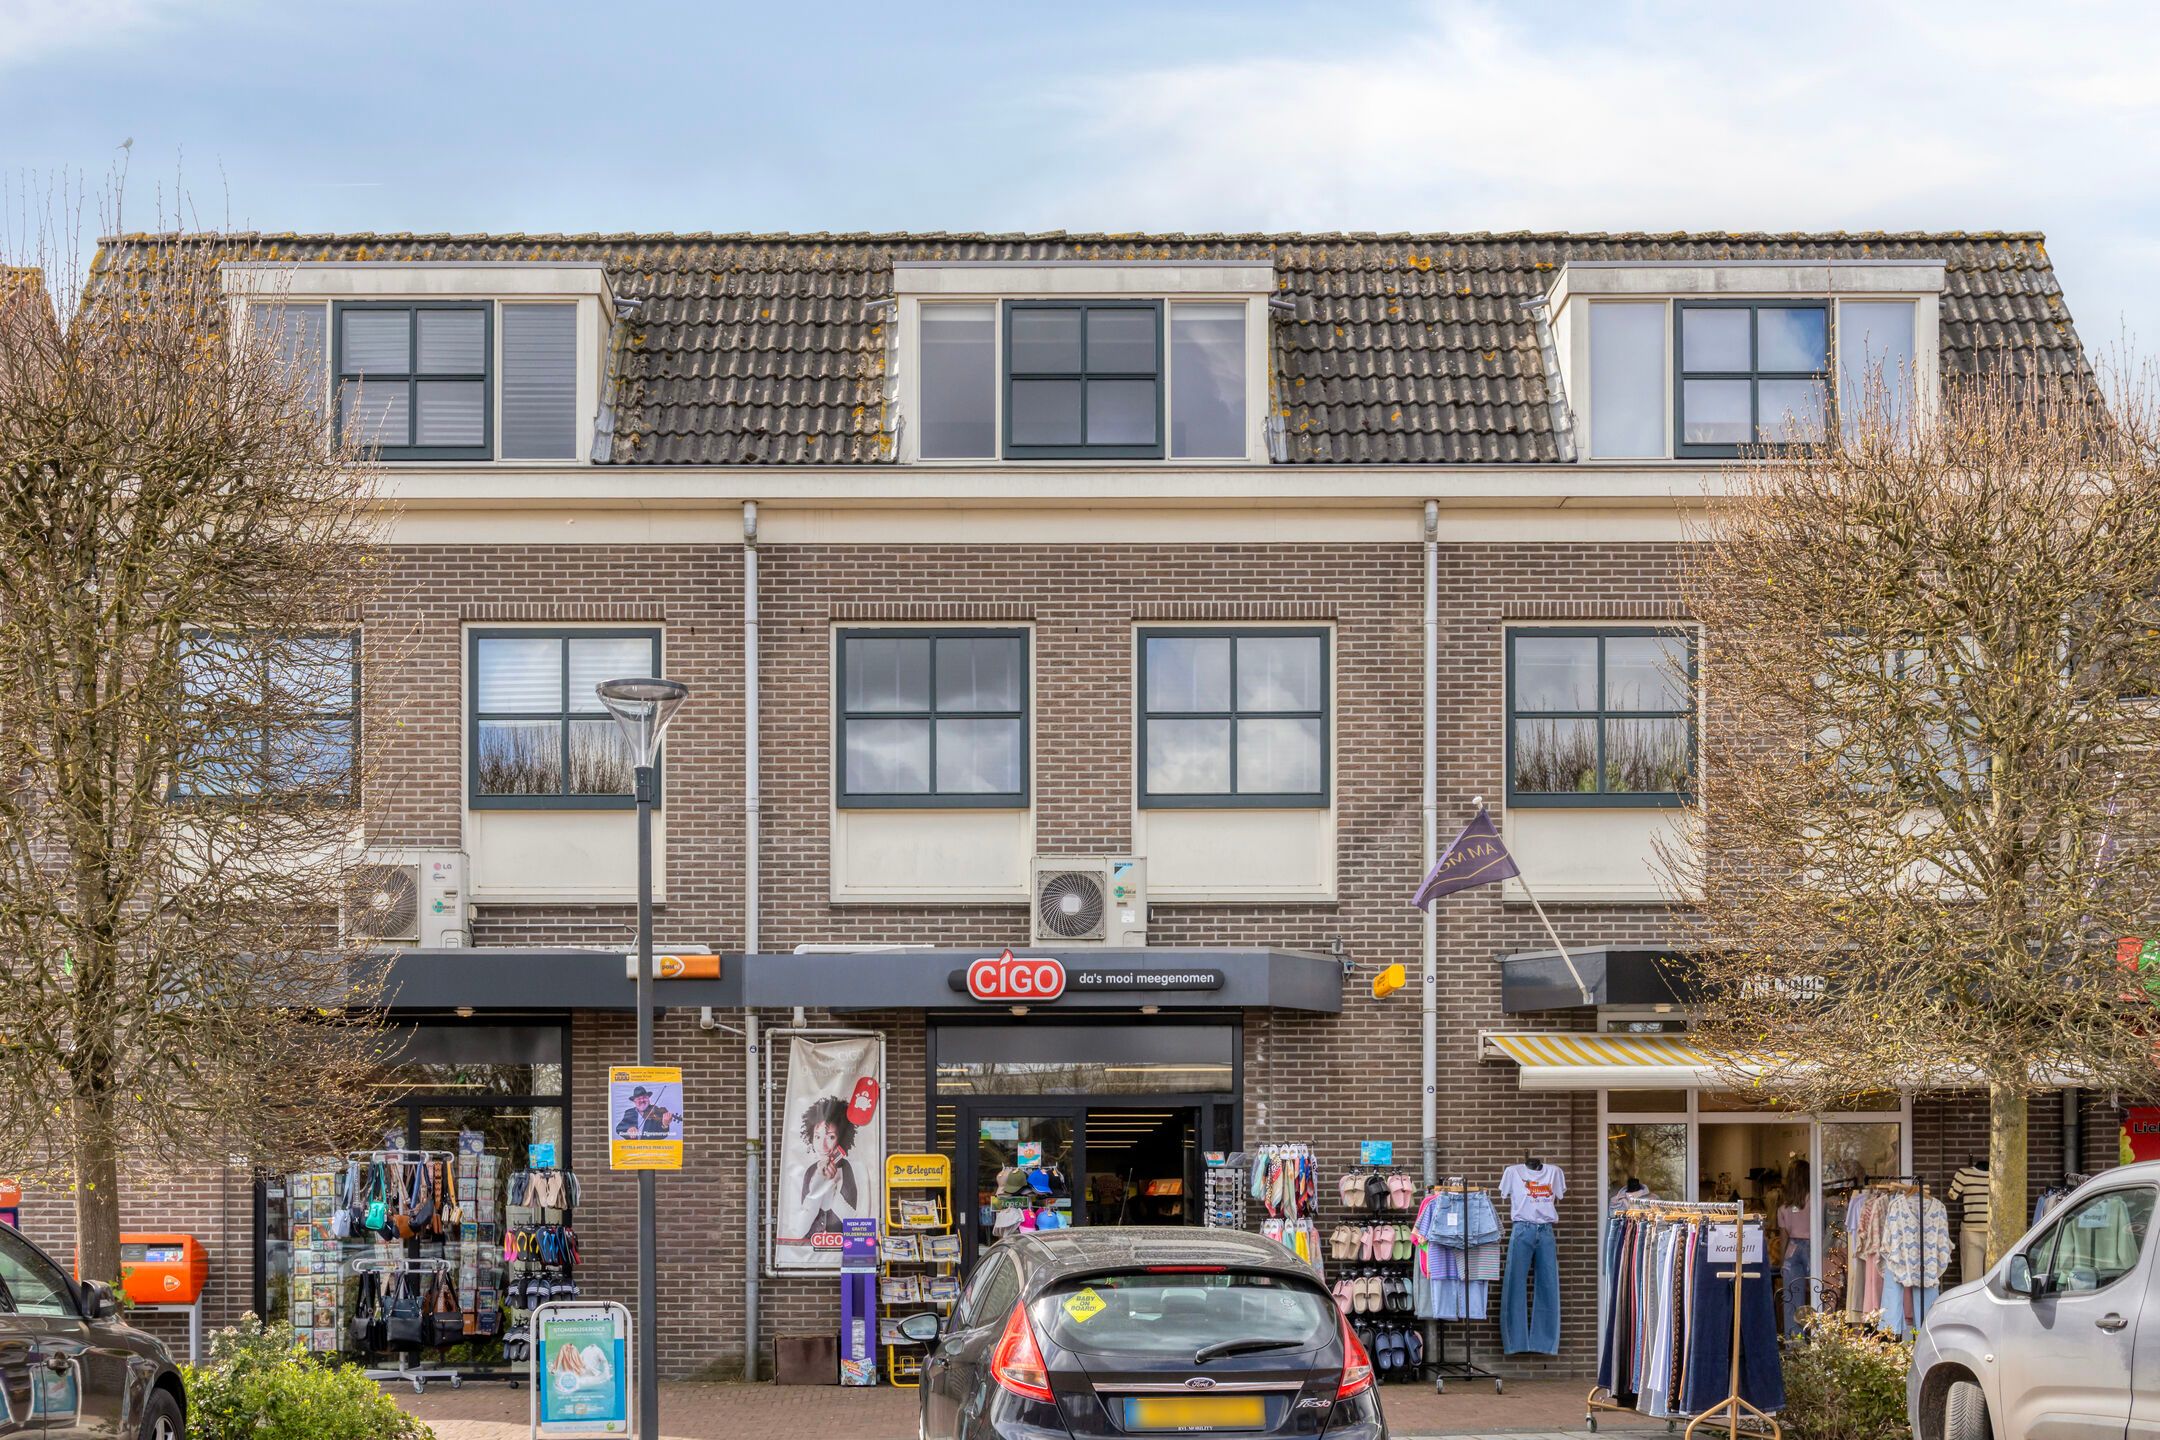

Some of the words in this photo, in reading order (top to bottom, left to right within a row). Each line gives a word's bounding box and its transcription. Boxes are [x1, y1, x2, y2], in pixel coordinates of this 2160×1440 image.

[975, 952, 1058, 993] CIGO
[1079, 973, 1102, 984] da's
[1105, 973, 1133, 984] mooi
[1136, 974, 1215, 986] meegenomen
[907, 1165, 944, 1176] Telegraaf
[1716, 1245, 1756, 1253] Kortig!!!
